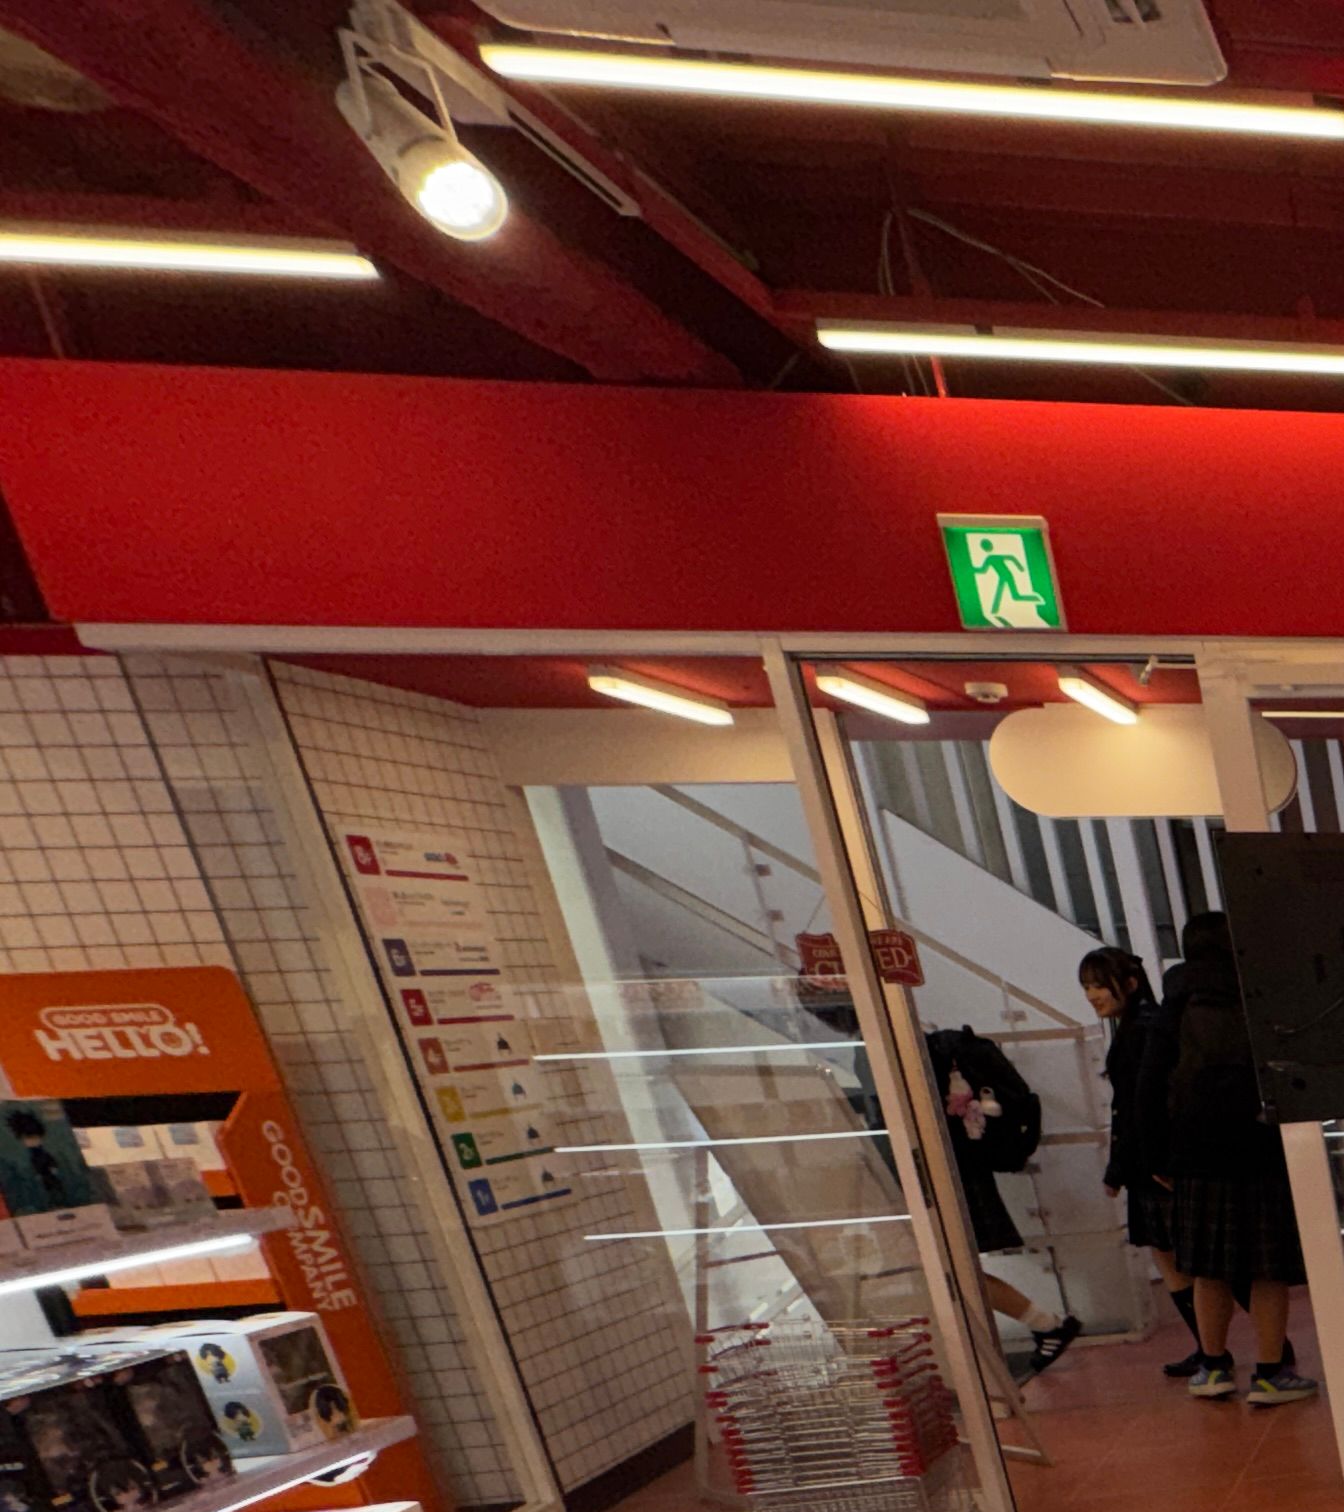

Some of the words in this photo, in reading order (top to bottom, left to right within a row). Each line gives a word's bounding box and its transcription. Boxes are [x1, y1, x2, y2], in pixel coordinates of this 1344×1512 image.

[34, 1022, 210, 1061] HELLO!
[51, 1013, 106, 1026] GOOD
[110, 1009, 163, 1024] SMILE
[262, 1119, 309, 1207] GOOD
[299, 1205, 358, 1311] SMILE
[273, 1190, 335, 1311] CMPANY
